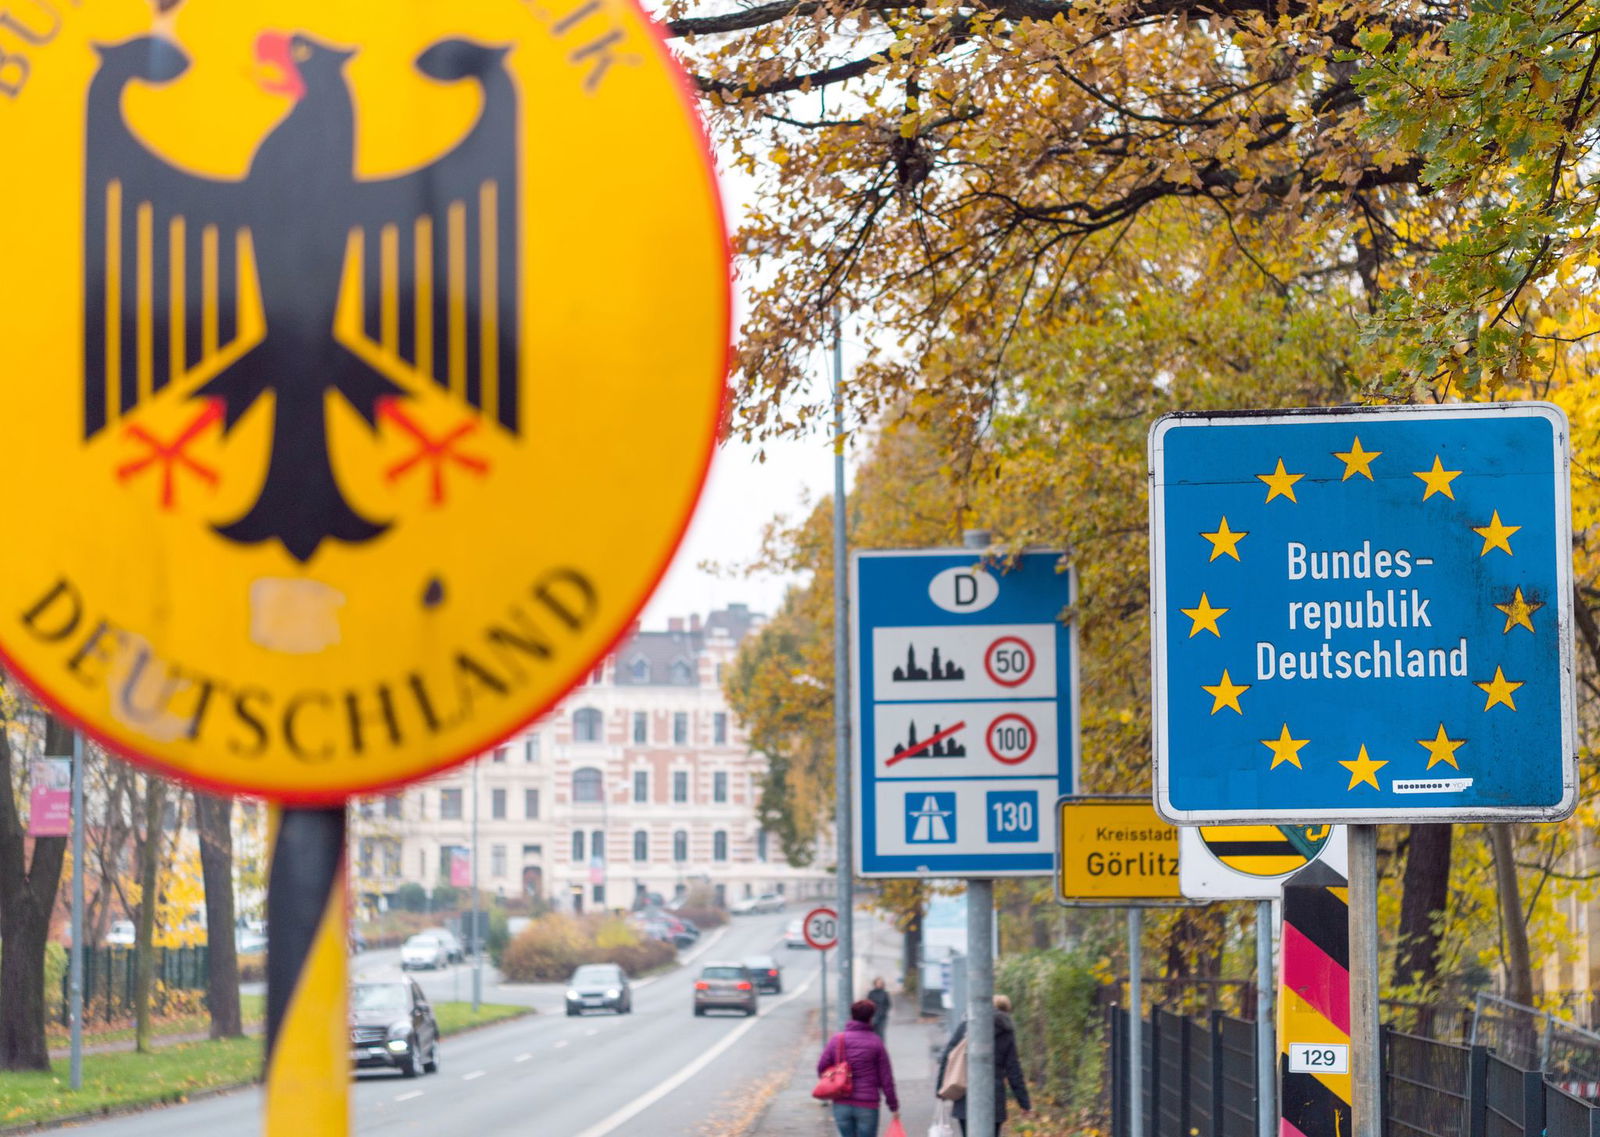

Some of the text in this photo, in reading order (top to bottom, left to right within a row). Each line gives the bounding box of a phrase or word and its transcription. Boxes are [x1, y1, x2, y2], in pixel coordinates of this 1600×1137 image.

[1287, 540, 1435, 580] Bundes-
[955, 574, 978, 606] D
[1288, 590, 1433, 640] republik
[20, 565, 600, 764] DEUTSCHLAND
[996, 650, 1026, 674] 50
[1256, 637, 1468, 681] Deutschland
[996, 727, 1028, 751] 100
[993, 802, 1033, 832] 130
[1087, 851, 1180, 876] Görlitz
[812, 920, 836, 939] 30
[1302, 1050, 1336, 1066] 129
